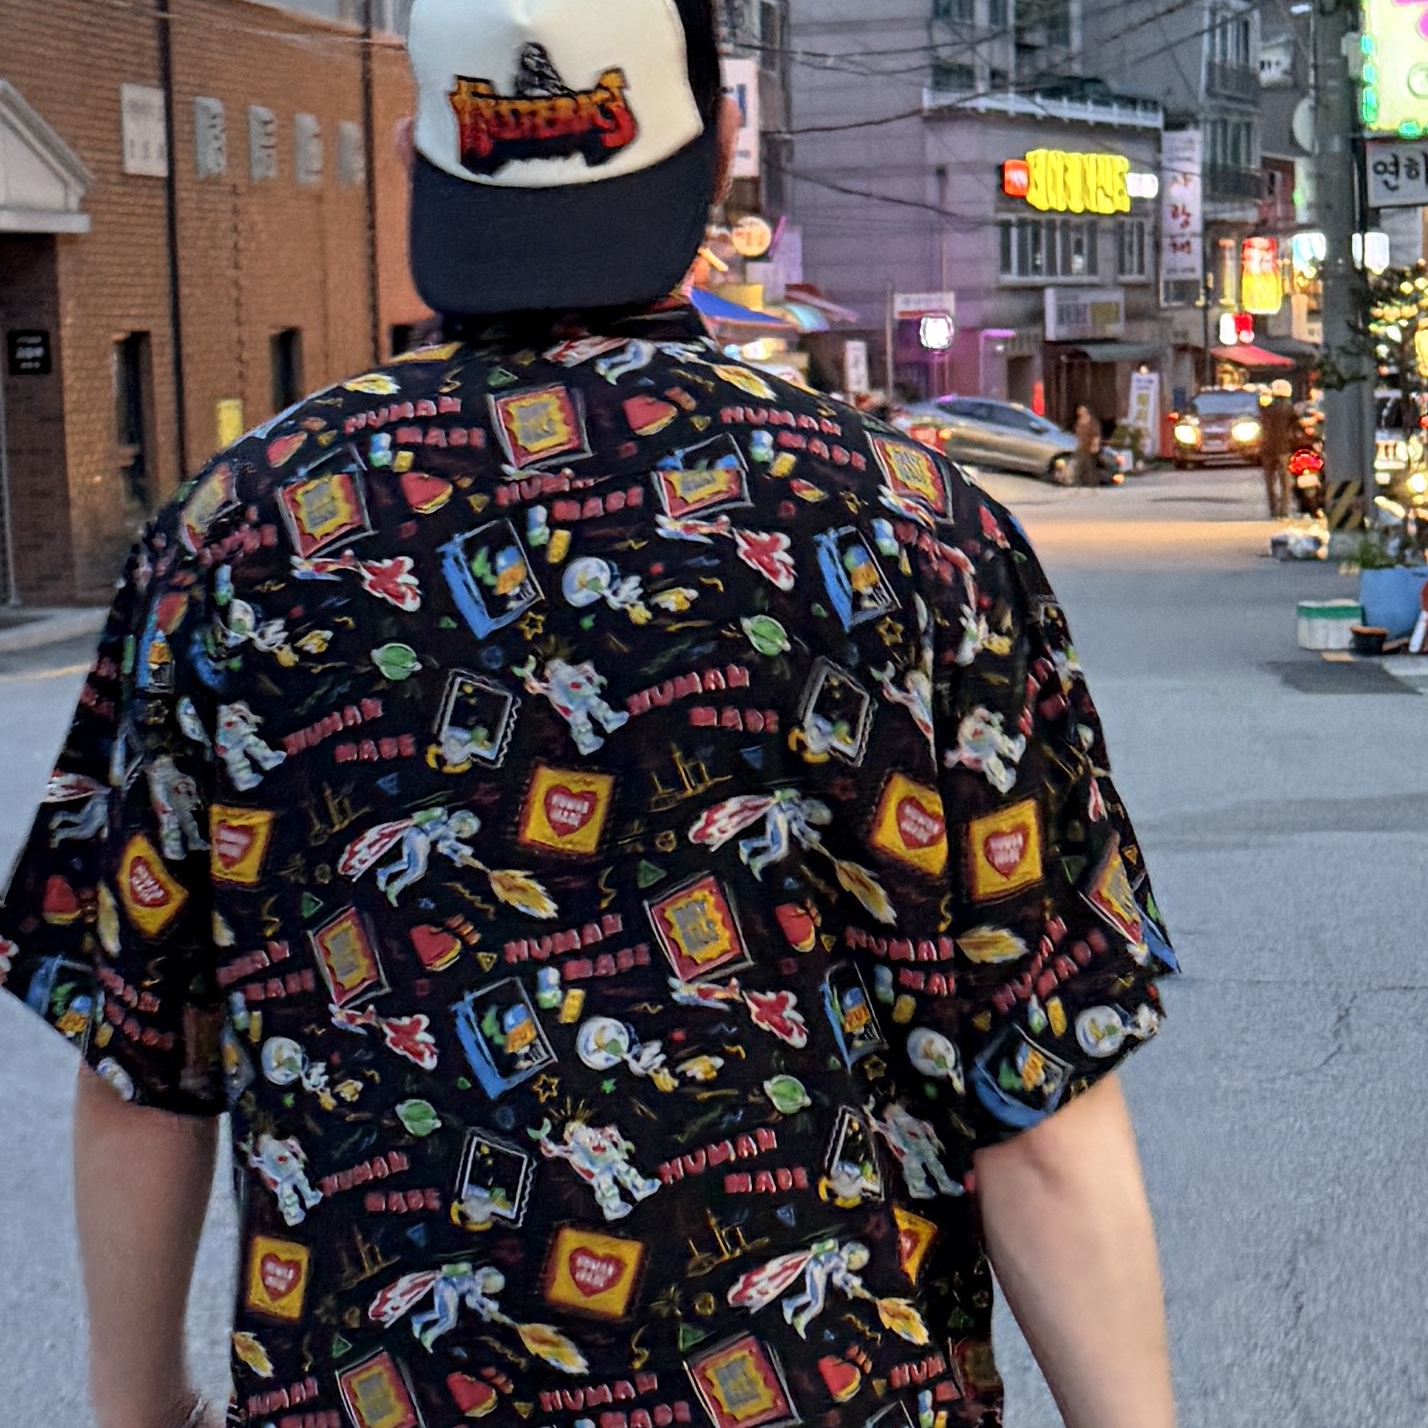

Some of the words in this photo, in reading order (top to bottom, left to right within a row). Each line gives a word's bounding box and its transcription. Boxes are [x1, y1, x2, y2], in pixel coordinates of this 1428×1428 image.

[343, 395, 462, 435] HUMAN
[719, 405, 842, 437] HUMAN
[394, 426, 486, 449] MADE
[776, 429, 867, 472] MADE
[551, 485, 645, 522] MADE
[626, 663, 750, 716] HUMAN
[283, 697, 384, 756] HUMAN
[689, 705, 780, 734] MADE
[334, 733, 416, 764] MADE
[504, 913, 624, 965] HUMAN
[844, 925, 955, 962] HUMAN
[563, 943, 652, 982] MADE
[319, 1150, 409, 1197] HUMAN
[658, 1126, 778, 1184] HUMAN
[724, 1166, 809, 1194] MADE
[364, 1187, 441, 1214] MADE
[539, 1371, 659, 1413] HUMAN
